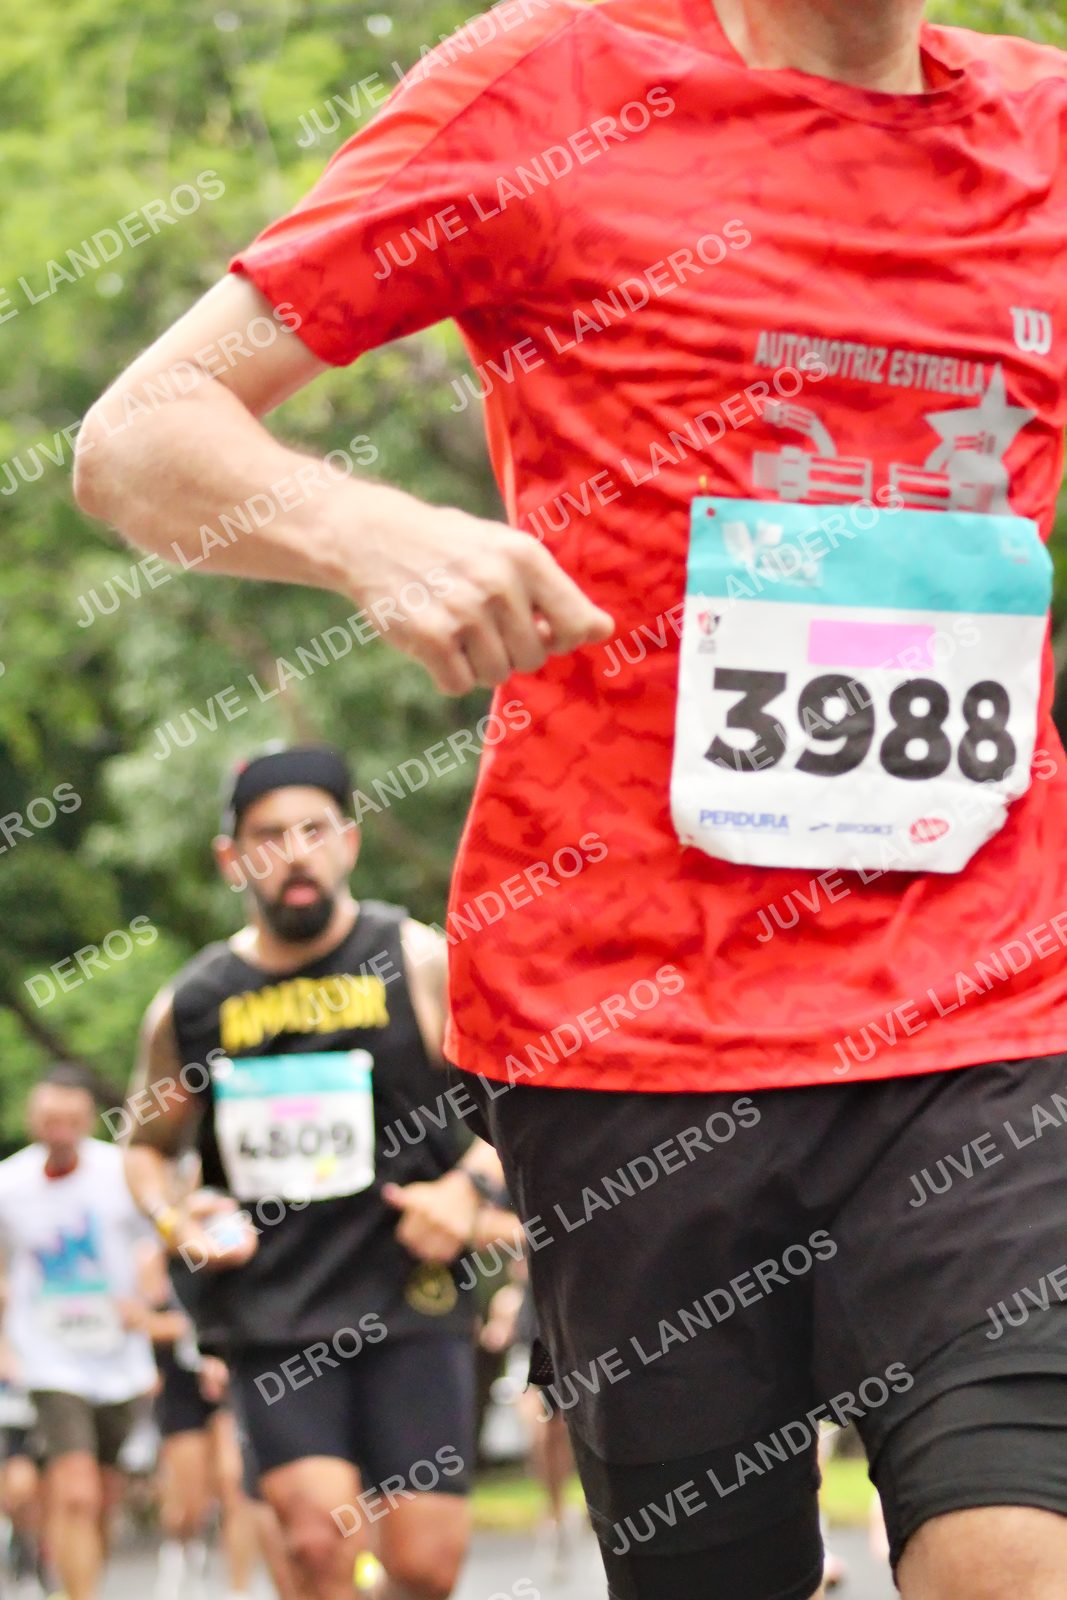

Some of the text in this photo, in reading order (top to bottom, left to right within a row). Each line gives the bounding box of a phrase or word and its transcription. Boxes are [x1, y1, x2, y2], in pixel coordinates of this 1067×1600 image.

[754, 330, 986, 396] AUTOMOTRIZ ESTRELLA
[704, 666, 1016, 783] 3988
[699, 808, 790, 831] PERDURA
